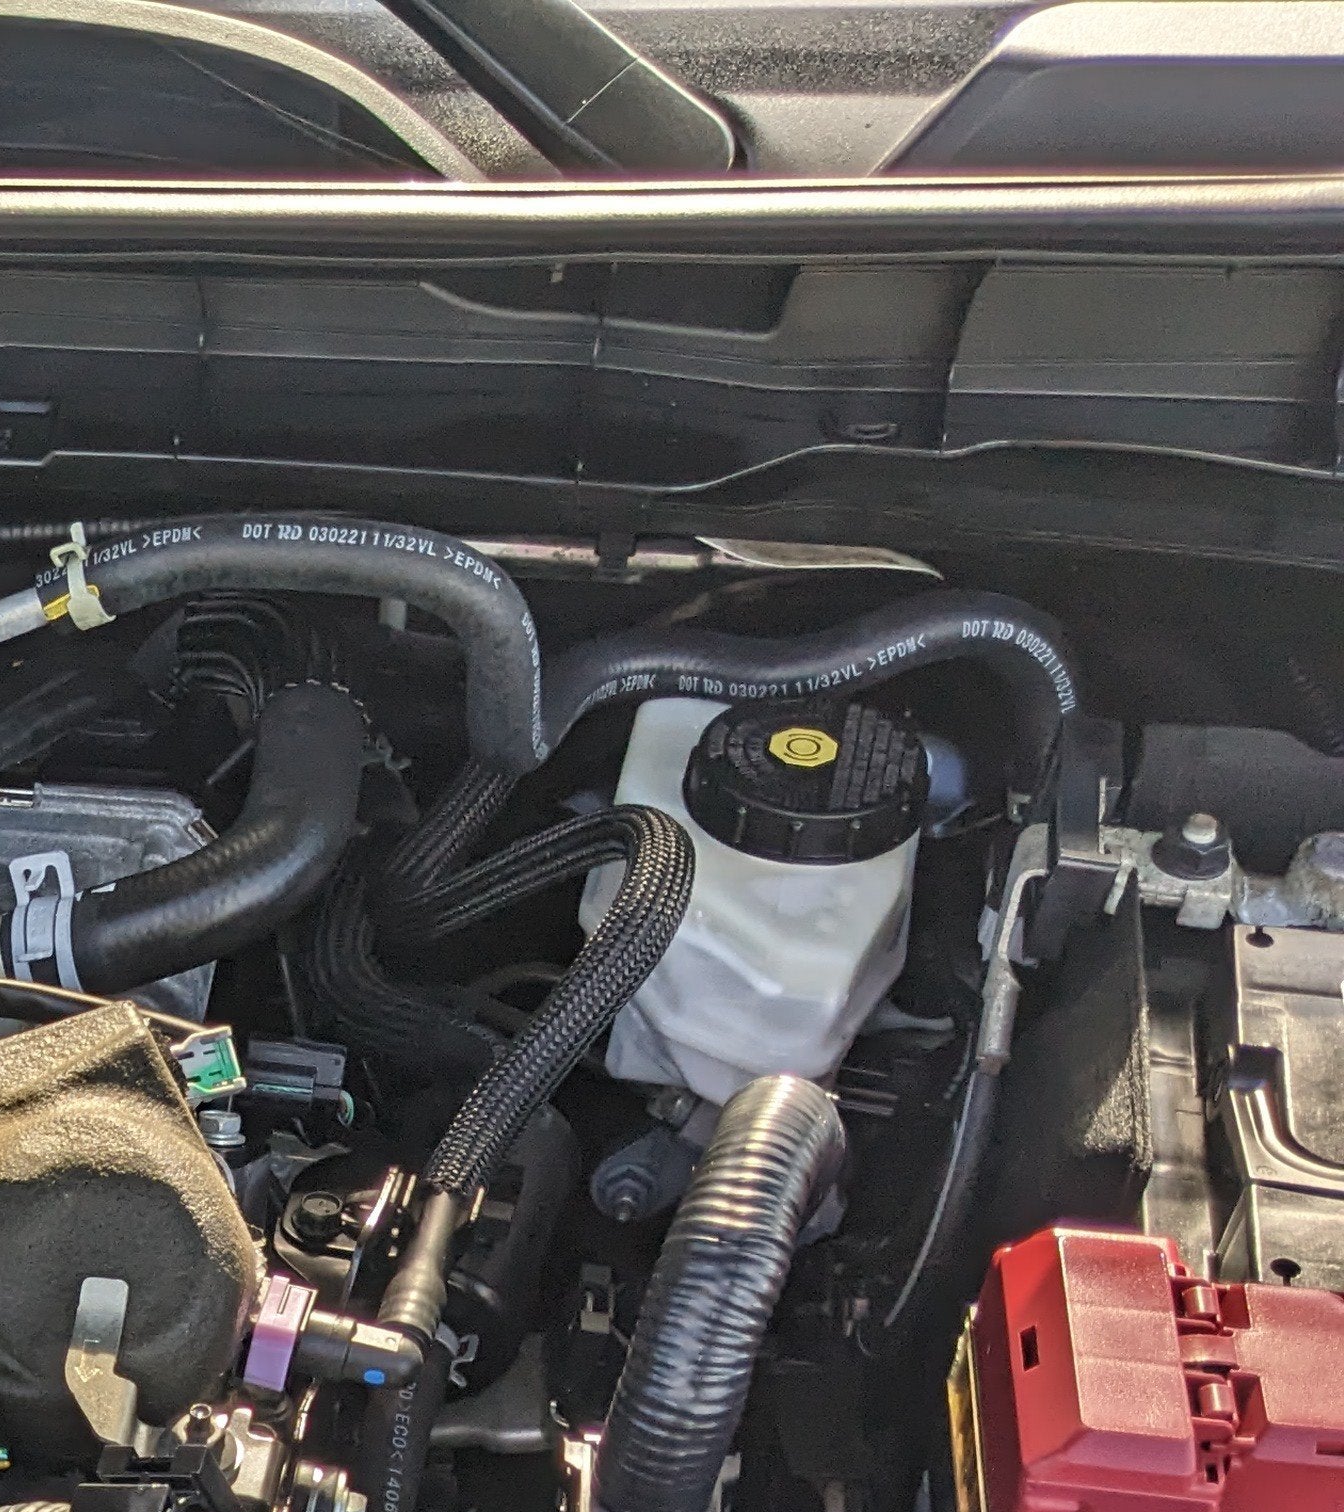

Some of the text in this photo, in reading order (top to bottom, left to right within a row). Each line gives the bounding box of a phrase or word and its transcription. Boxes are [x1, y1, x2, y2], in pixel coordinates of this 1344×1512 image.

[242, 523, 273, 539] DOT
[962, 620, 990, 638] DOT
[678, 674, 699, 692] DOT
